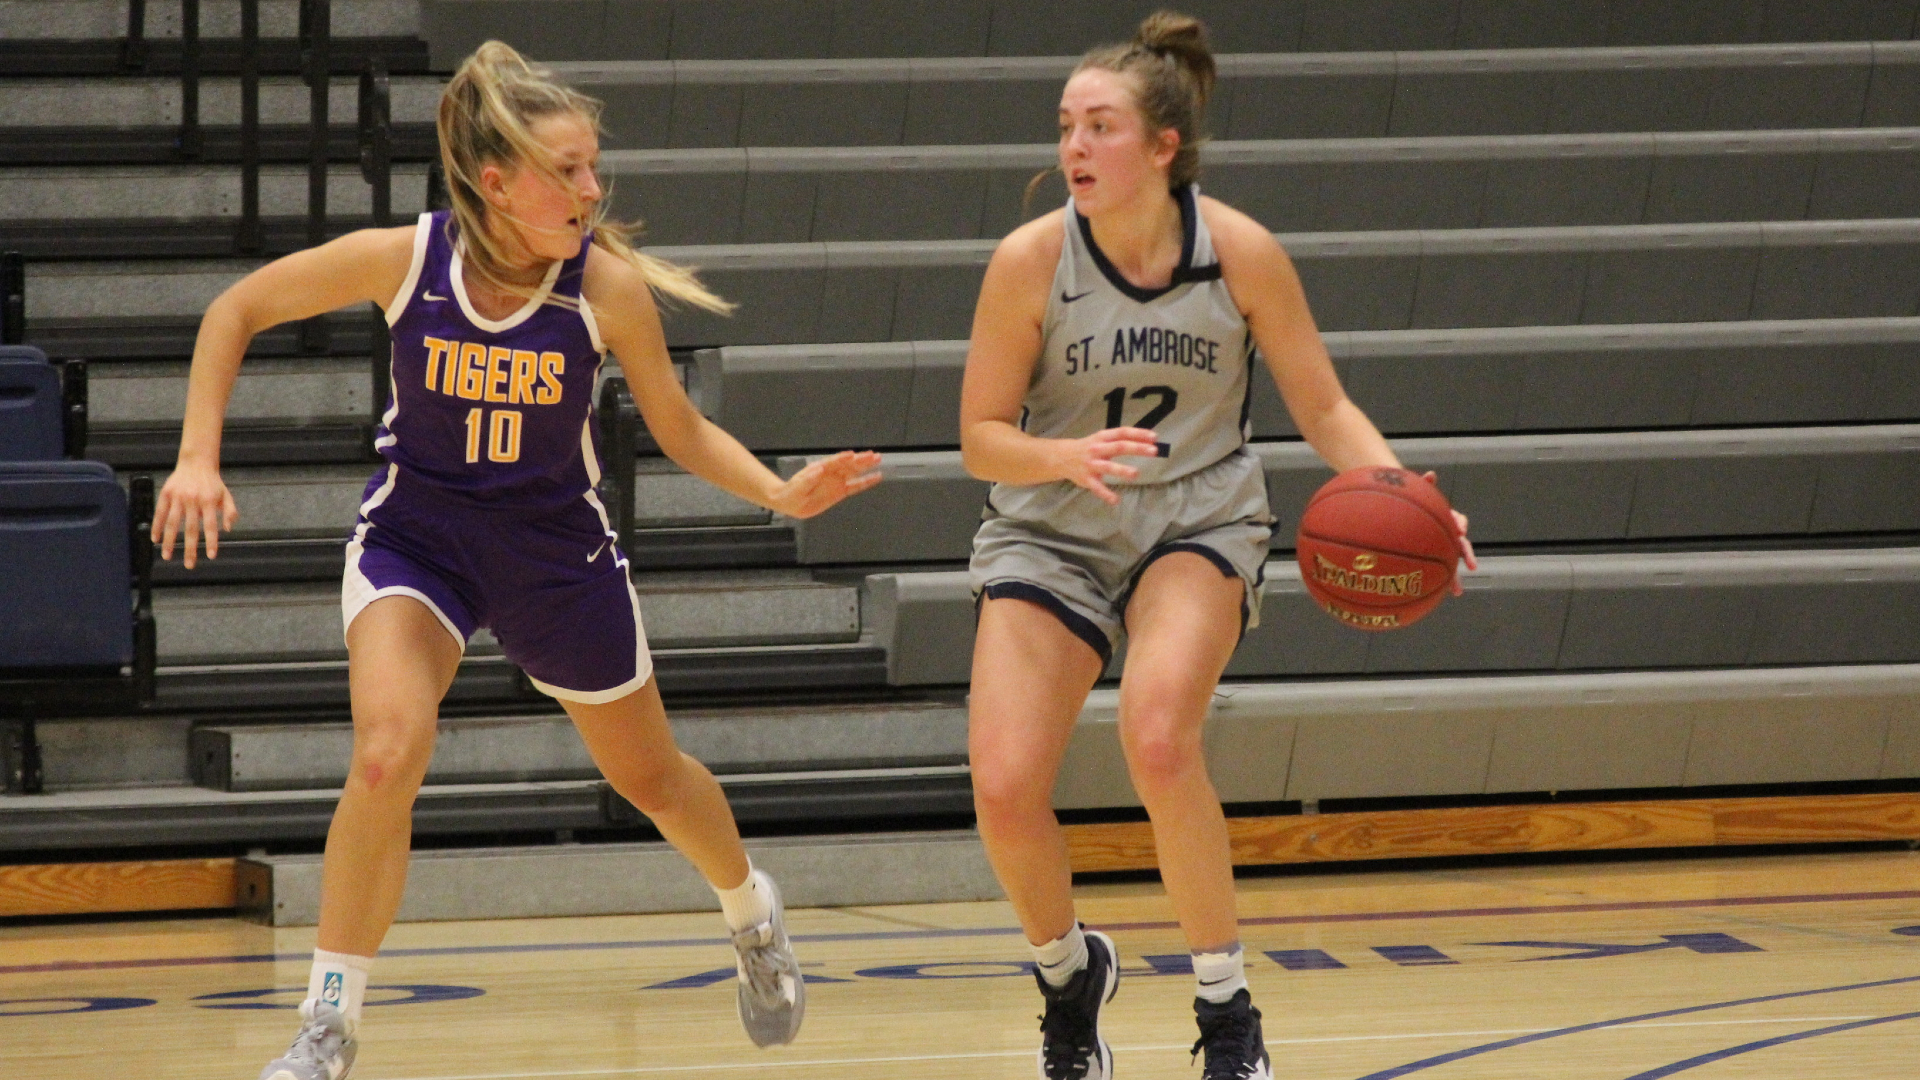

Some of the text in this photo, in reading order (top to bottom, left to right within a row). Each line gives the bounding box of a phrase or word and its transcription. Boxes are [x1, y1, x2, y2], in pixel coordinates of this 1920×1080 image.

[423, 335, 565, 405] TIGERS
[1065, 326, 1220, 376] ST. AMBROSE
[464, 408, 522, 463] 10
[1103, 385, 1179, 458] 12
[1312, 553, 1424, 597] SPALDING
